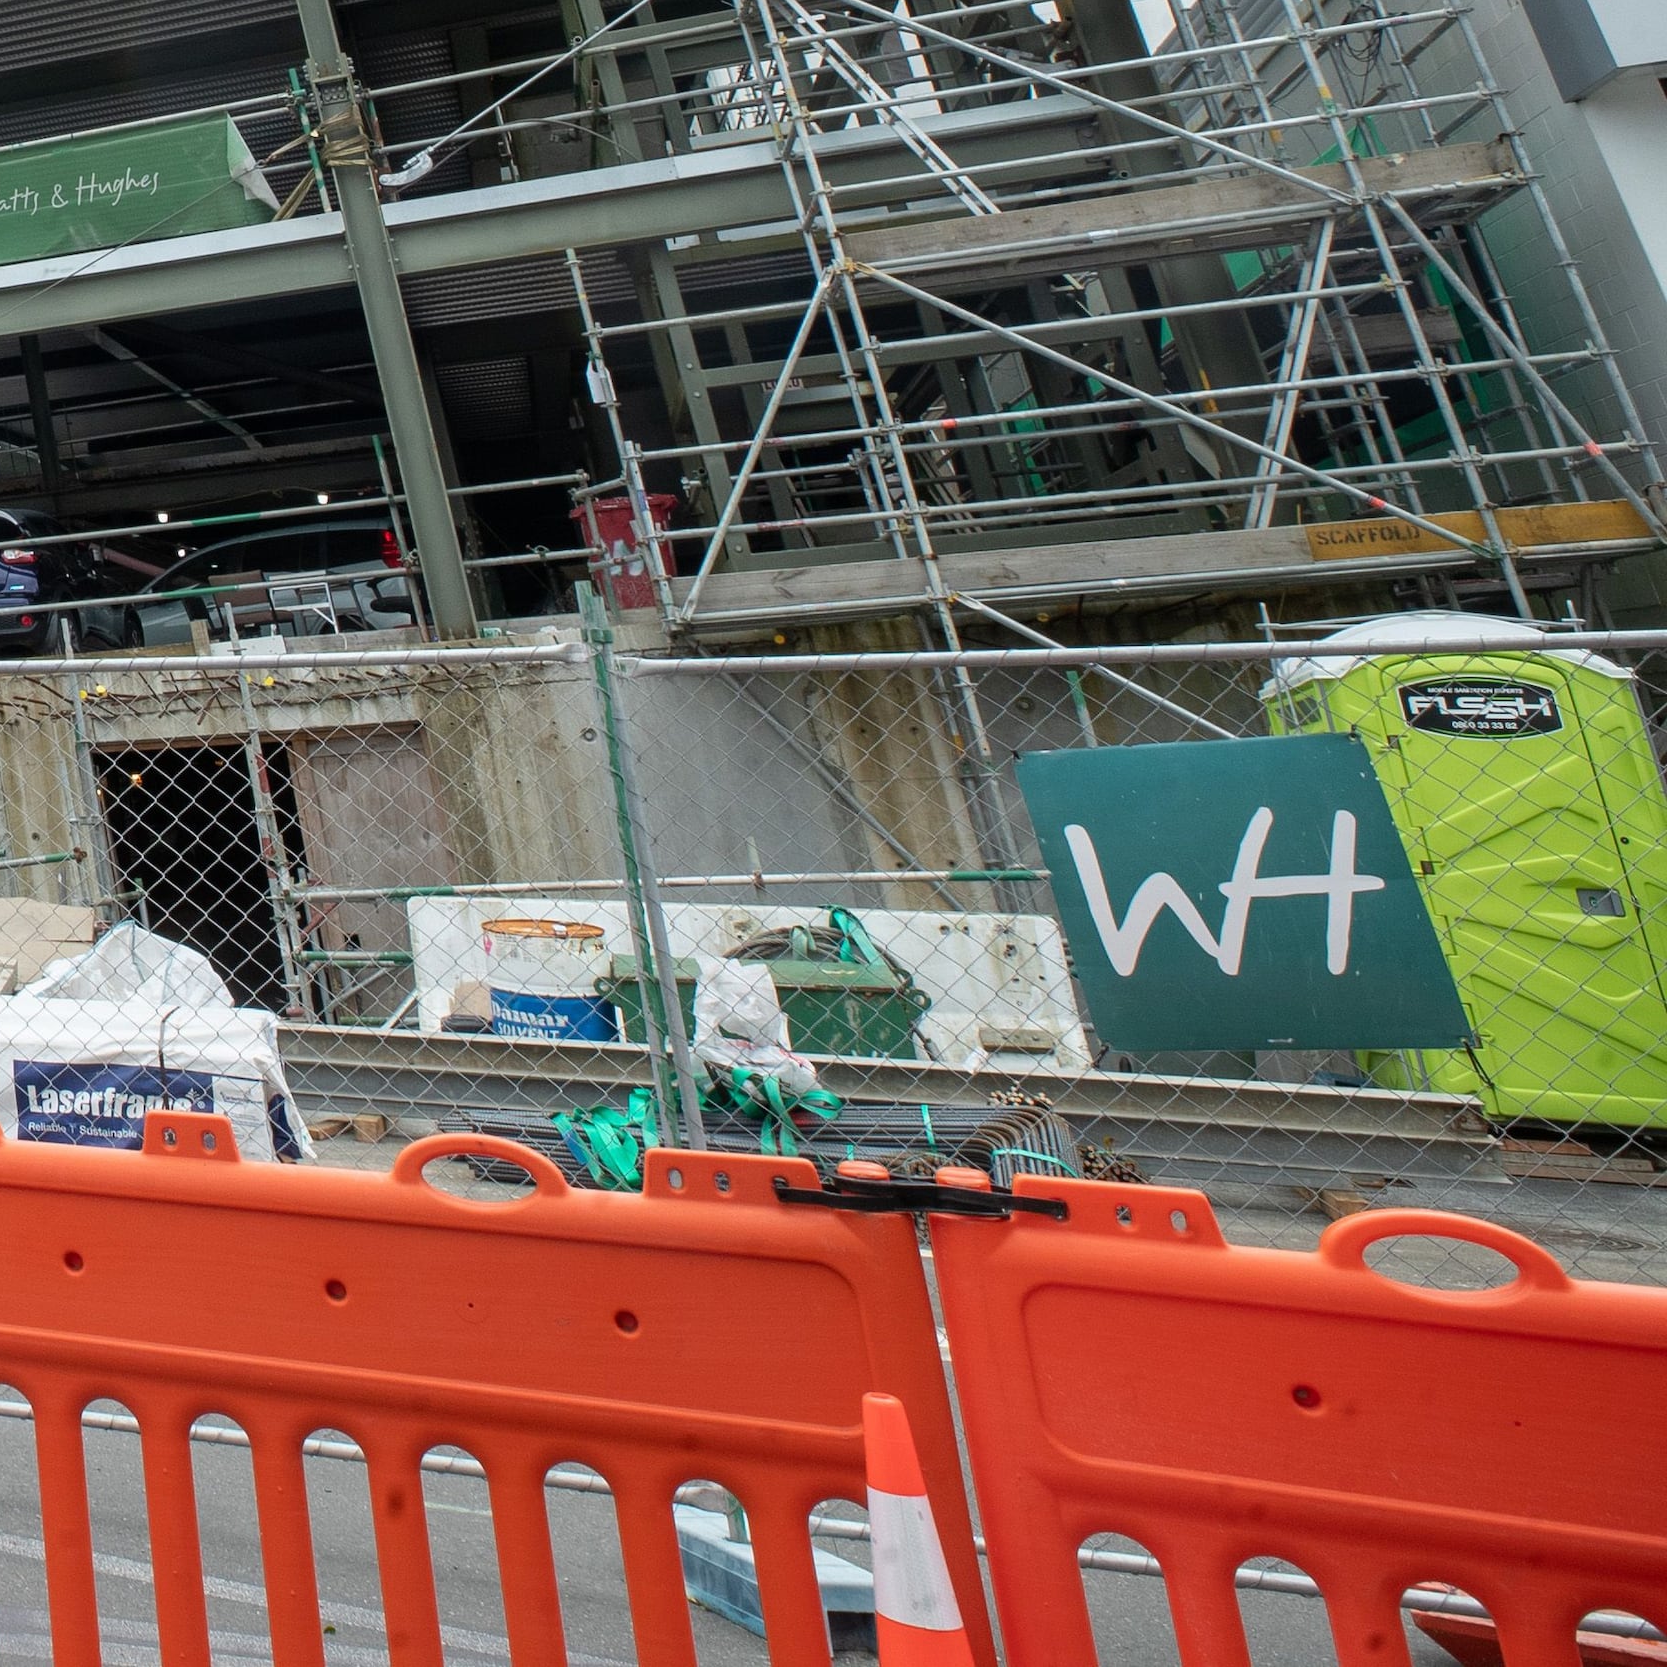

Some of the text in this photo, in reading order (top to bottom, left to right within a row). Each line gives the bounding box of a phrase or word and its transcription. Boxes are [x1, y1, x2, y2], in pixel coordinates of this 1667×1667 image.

[50, 182, 66, 208] &
[74, 166, 161, 208] Hughes
[1315, 525, 1420, 546] SCAFFOLD
[1063, 805, 1386, 978] WH
[491, 1000, 568, 1027] Damar
[28, 1121, 138, 1139] Reliable Sustainable
